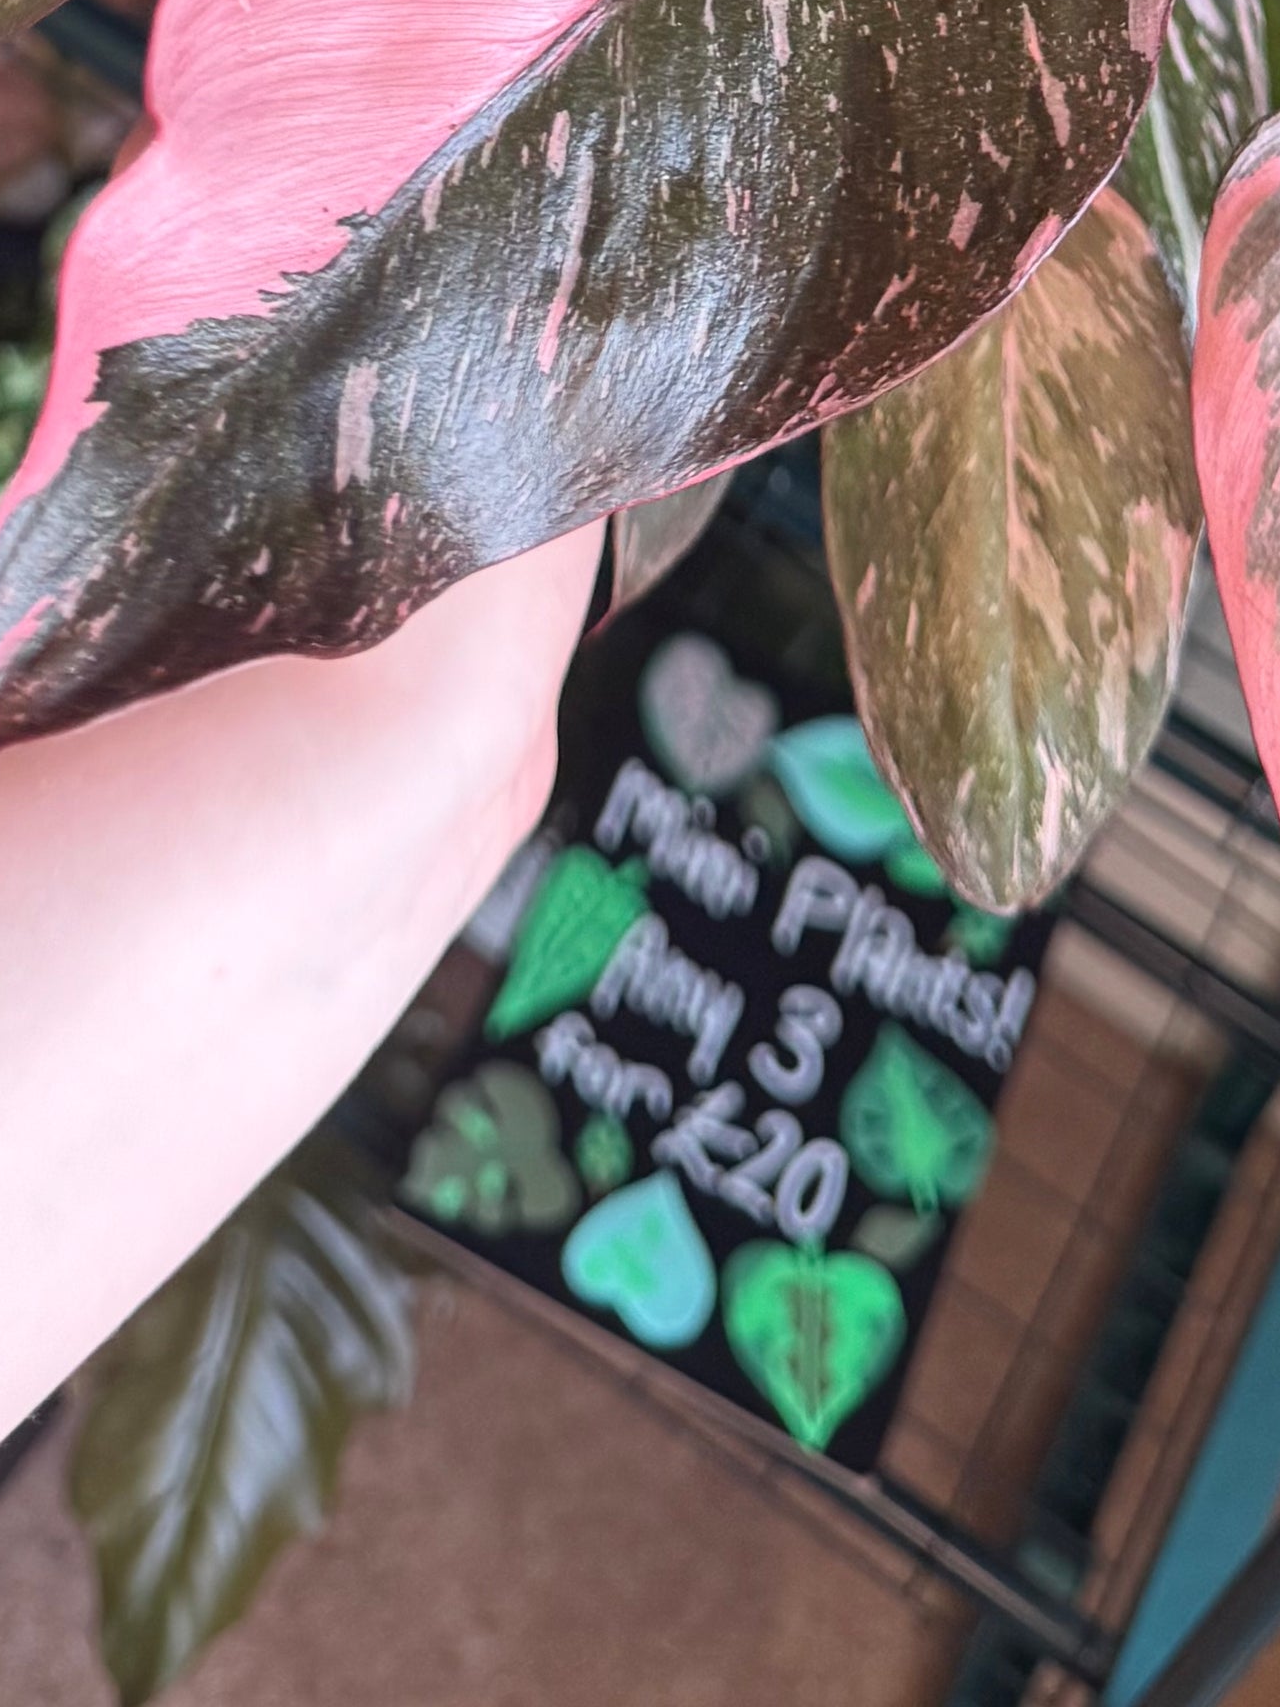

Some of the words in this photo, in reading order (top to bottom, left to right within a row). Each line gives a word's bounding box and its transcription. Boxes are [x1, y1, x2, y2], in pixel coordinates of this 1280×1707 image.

[593, 755, 771, 921] Mini
[589, 911, 746, 1086] Any
[747, 983, 844, 1106] 3
[533, 1010, 674, 1124] for
[649, 1080, 850, 1242] £20
